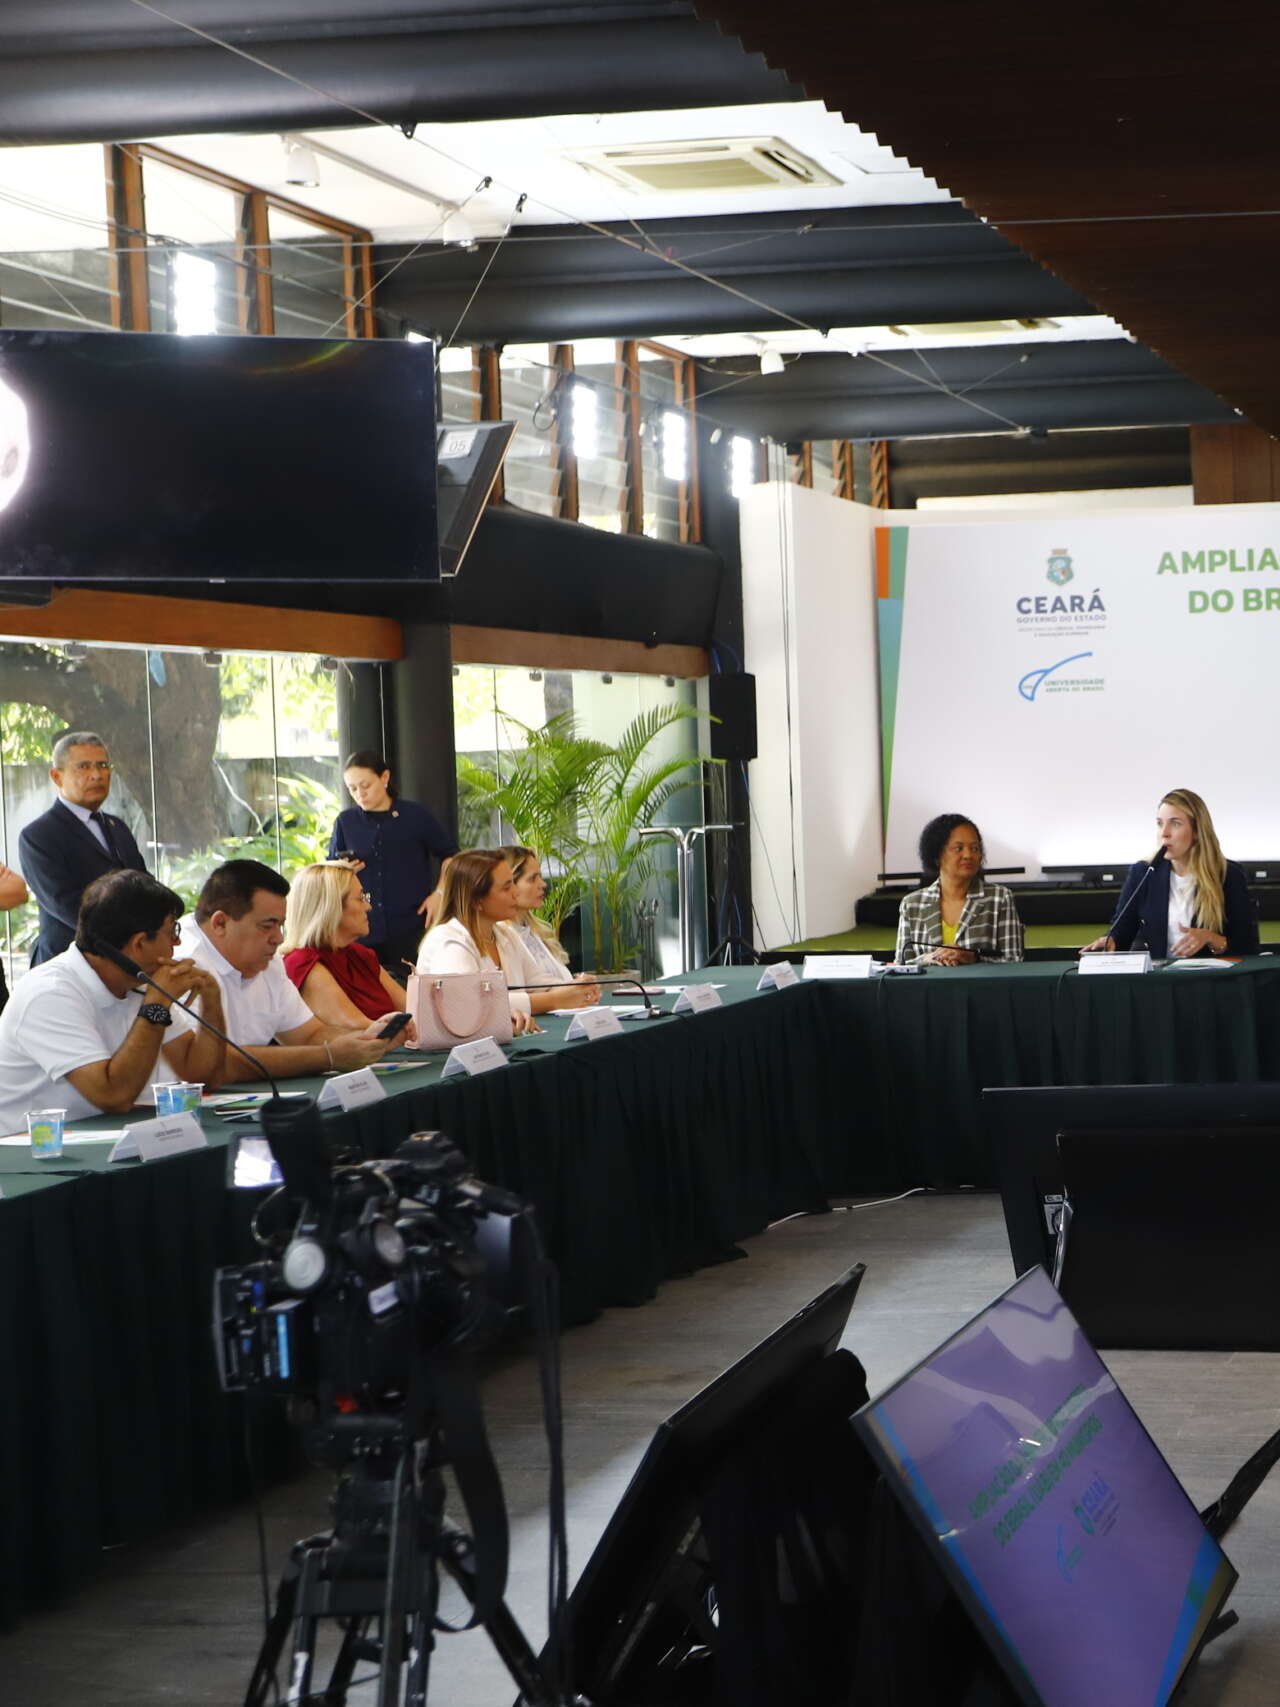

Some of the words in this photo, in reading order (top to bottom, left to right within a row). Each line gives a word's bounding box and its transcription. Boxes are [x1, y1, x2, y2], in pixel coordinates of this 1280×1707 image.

[1016, 588, 1106, 615] CEARÁ
[1188, 589, 1235, 614] DO
[1016, 616, 1058, 624] GOVERNO
[1059, 615, 1073, 623] DO
[1074, 614, 1107, 622] ESTADO
